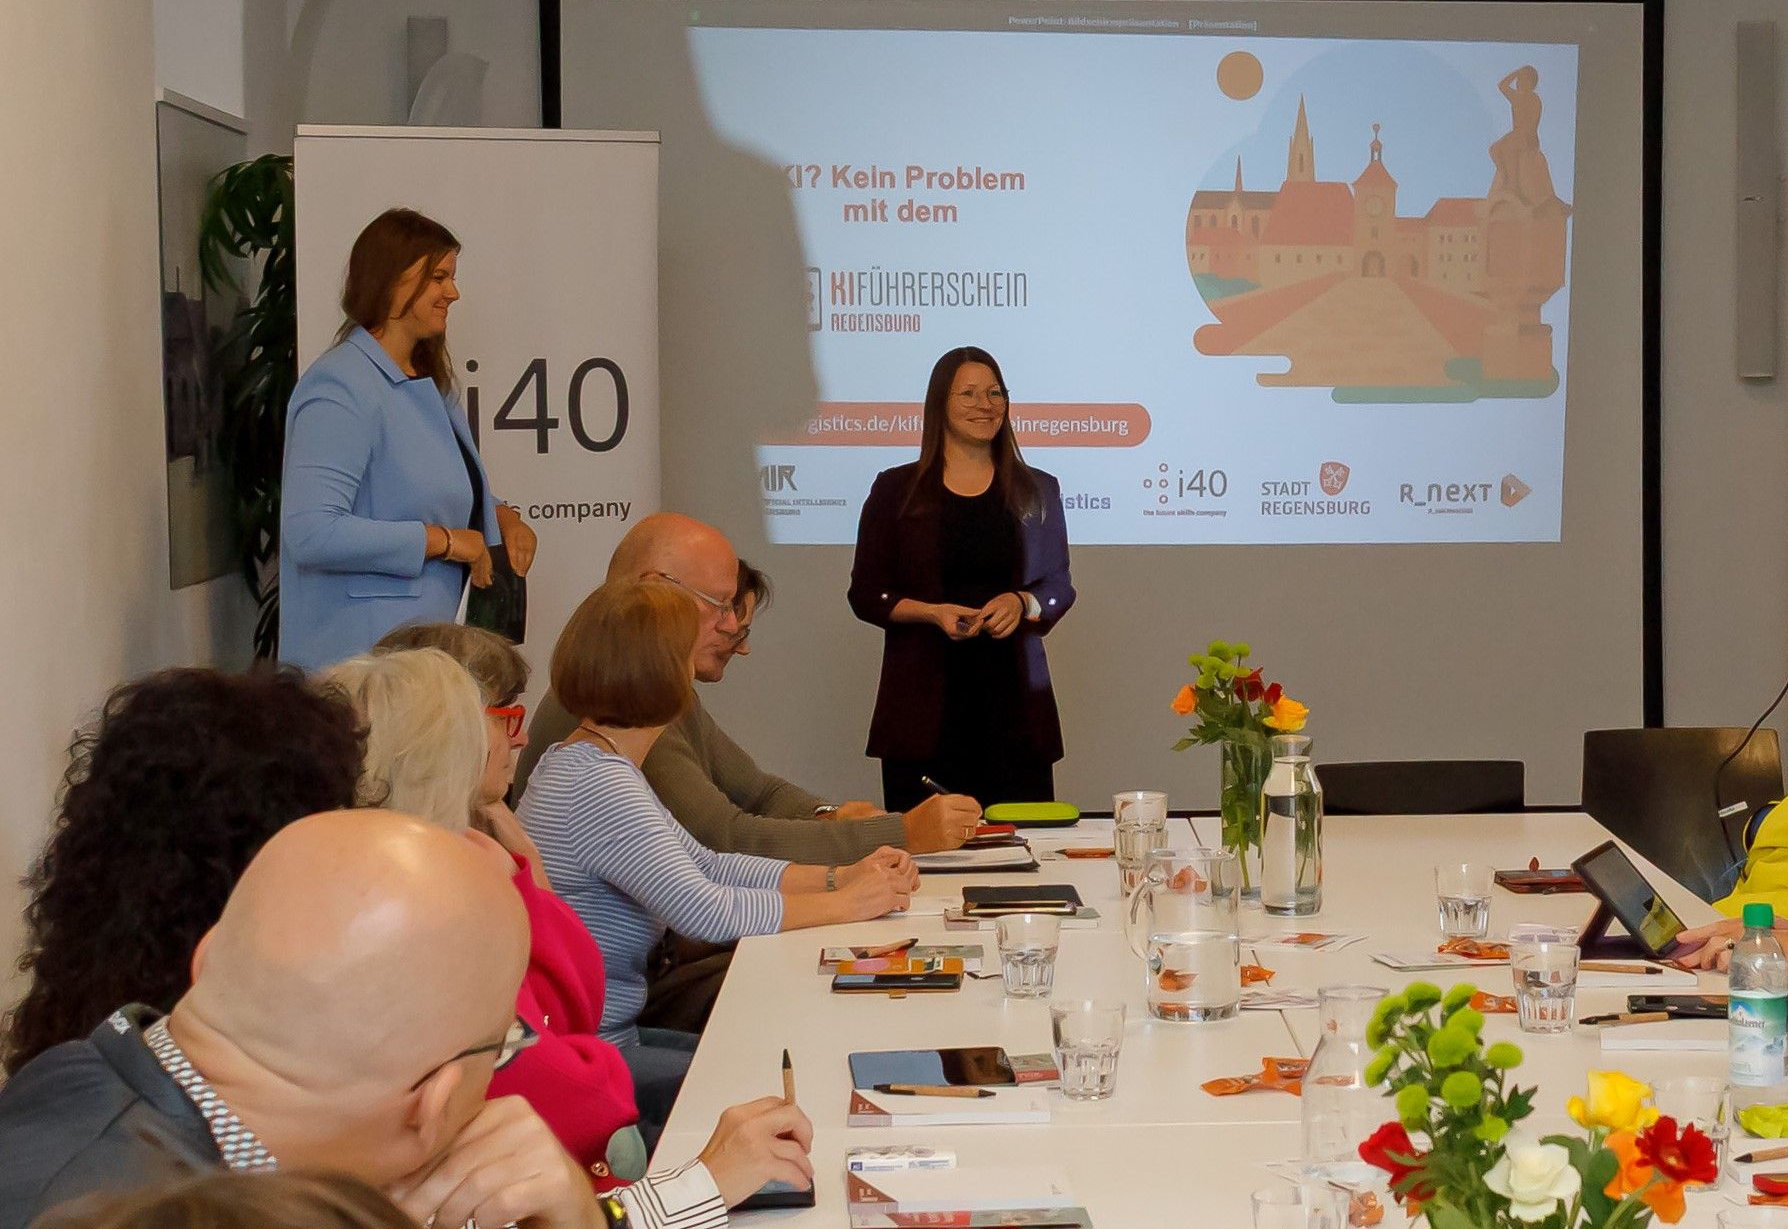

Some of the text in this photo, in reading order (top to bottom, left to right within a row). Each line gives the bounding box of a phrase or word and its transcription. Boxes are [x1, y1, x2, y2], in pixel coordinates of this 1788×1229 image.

[831, 164, 896, 189] Kein
[905, 165, 1025, 191] Problem
[843, 198, 959, 223] mit dem
[831, 313, 921, 333] REGENSBURG
[466, 357, 629, 454] i40
[1178, 470, 1228, 497] i40
[1261, 482, 1311, 496] STADT
[528, 501, 631, 523] company
[1261, 501, 1371, 516] REGENSBURG
